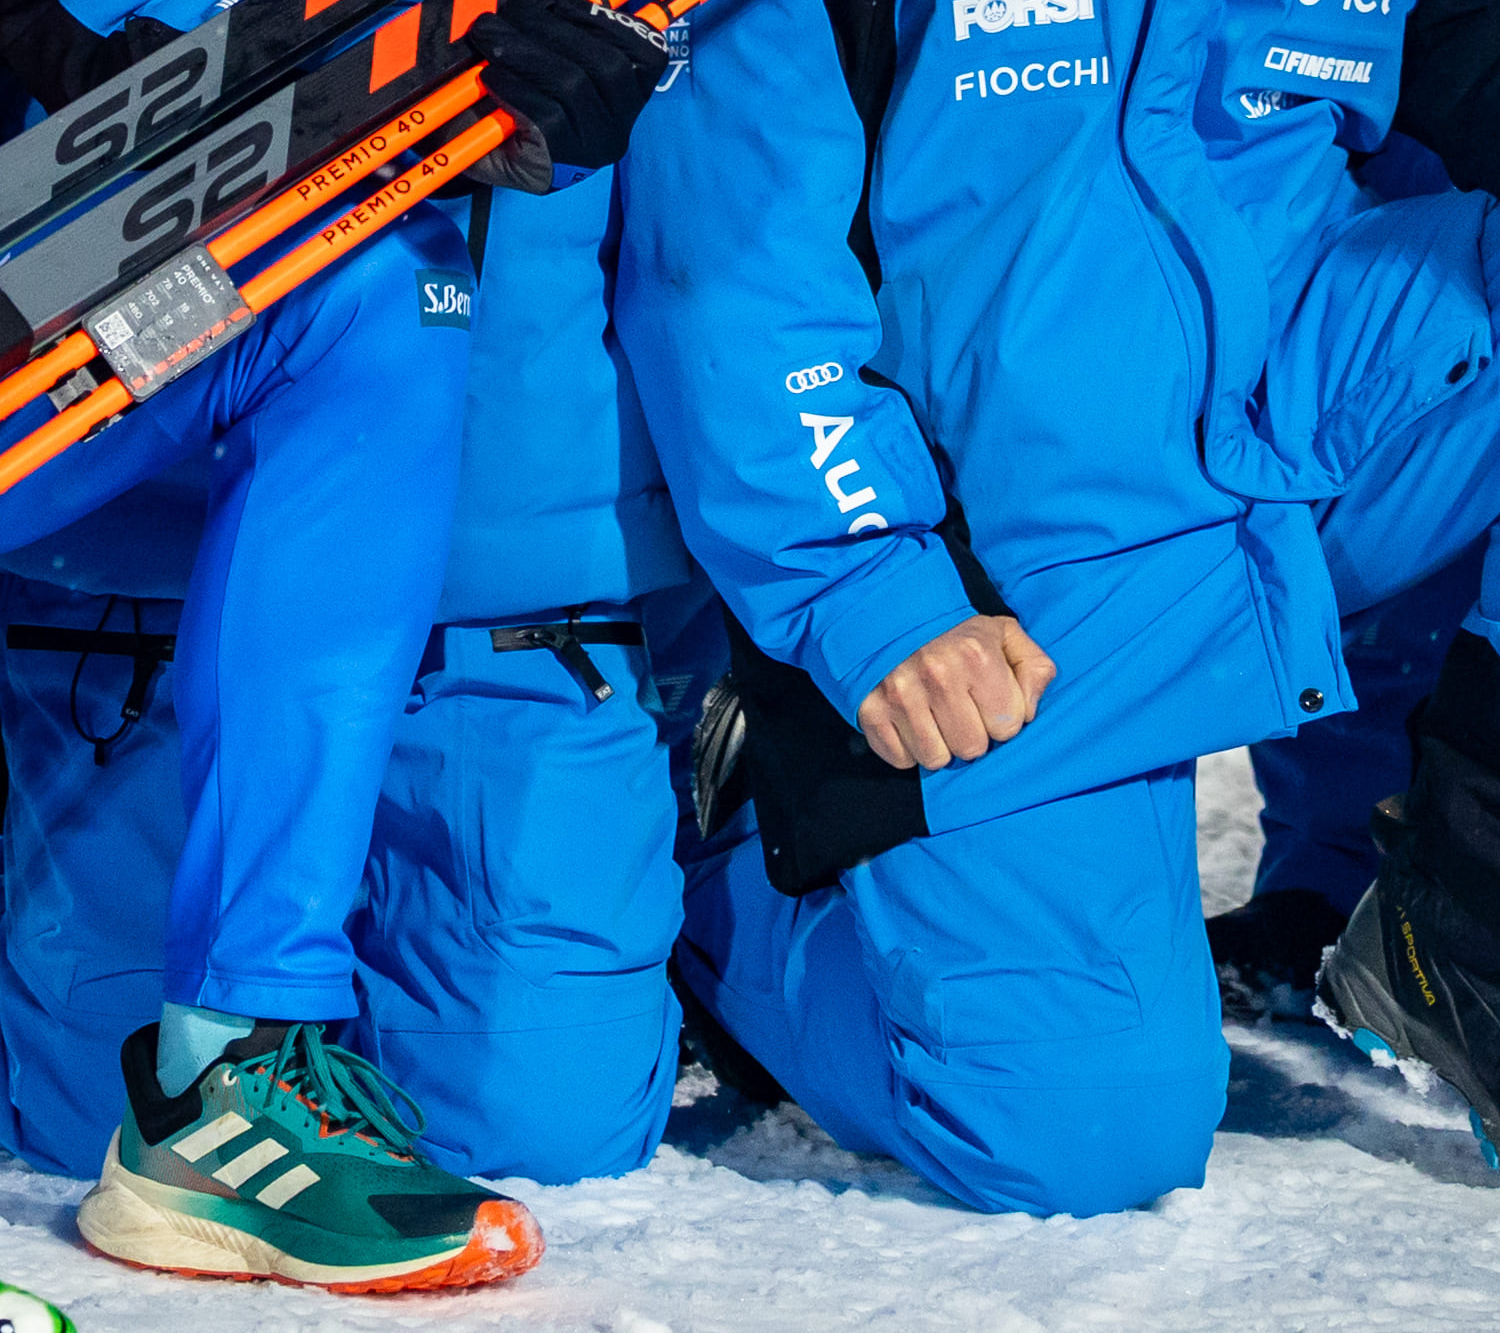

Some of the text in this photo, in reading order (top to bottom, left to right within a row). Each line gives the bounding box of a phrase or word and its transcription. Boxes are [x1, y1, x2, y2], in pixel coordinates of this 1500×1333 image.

[955, 55, 1109, 102] FIOCCHI
[1285, 51, 1373, 83] FINSTRAL
[52, 48, 207, 199] S2
[297, 109, 425, 200] PREMIO 40
[119, 121, 274, 275] S2
[323, 152, 449, 246] PREMIO 40
[174, 270, 187, 285] 40
[197, 255, 225, 291] ONE WAY
[1402, 921, 1435, 1006] SPORTIVA
